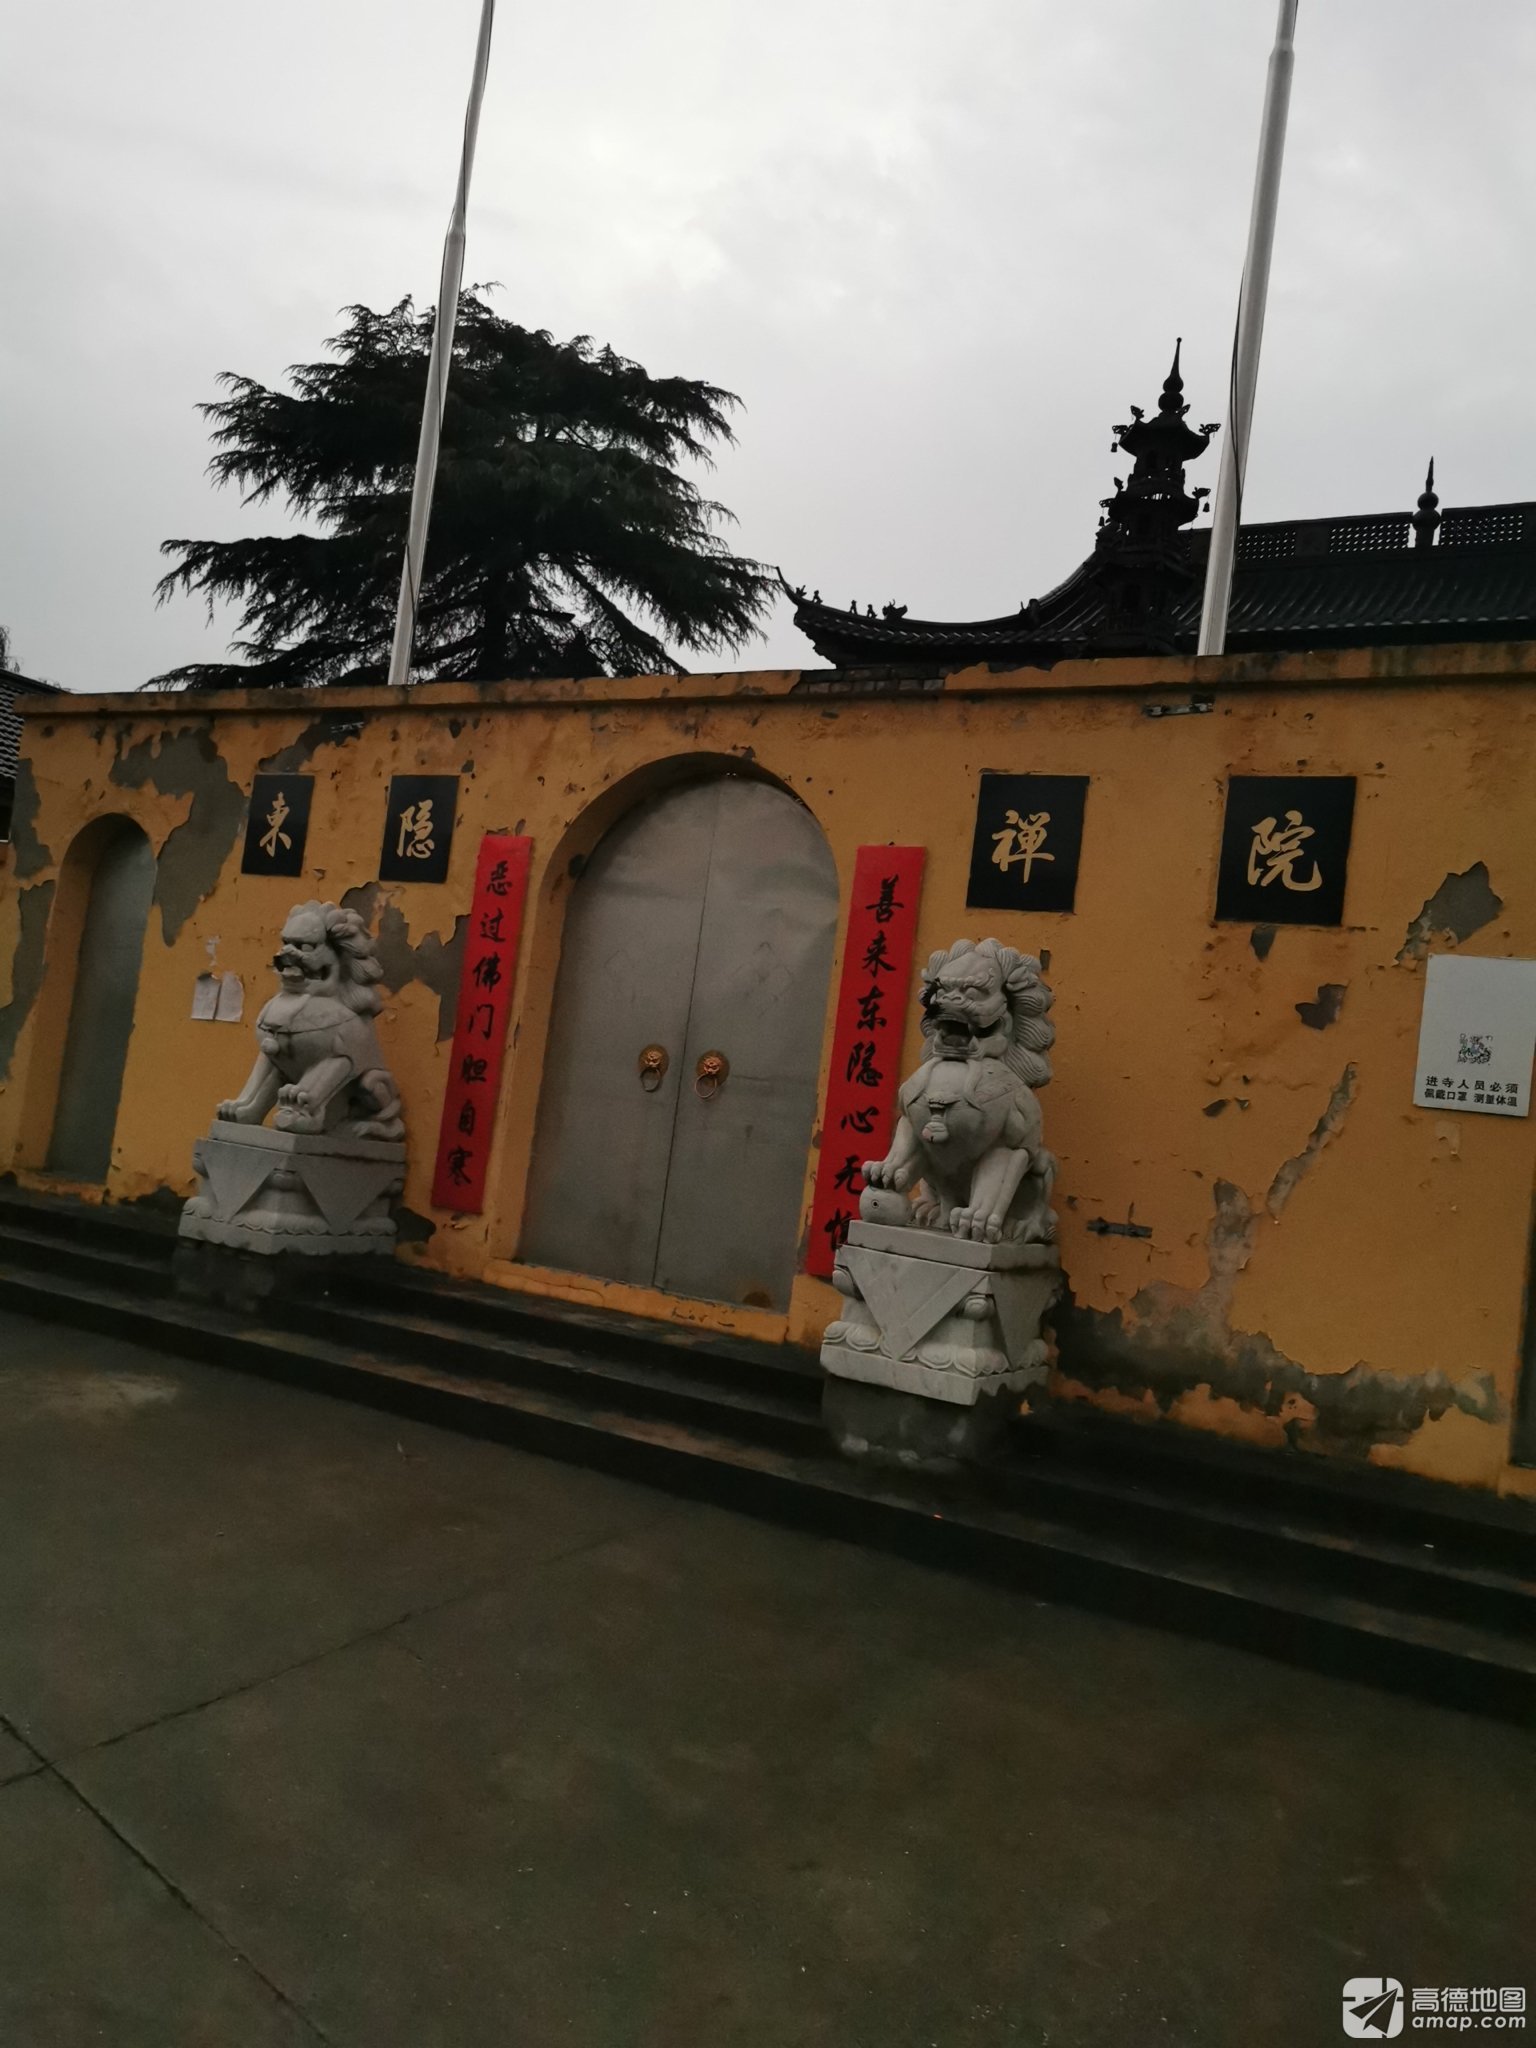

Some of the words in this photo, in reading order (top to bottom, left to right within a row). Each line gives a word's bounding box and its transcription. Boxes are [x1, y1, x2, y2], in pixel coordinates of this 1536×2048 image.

[992, 809, 1056, 884] 禅
[1247, 810, 1322, 891] 院
[1425, 1075, 1519, 1094] 进寺人员必须
[1424, 1088, 1468, 1102] 佩戴口罩
[1474, 1093, 1518, 1107] 测量体温
